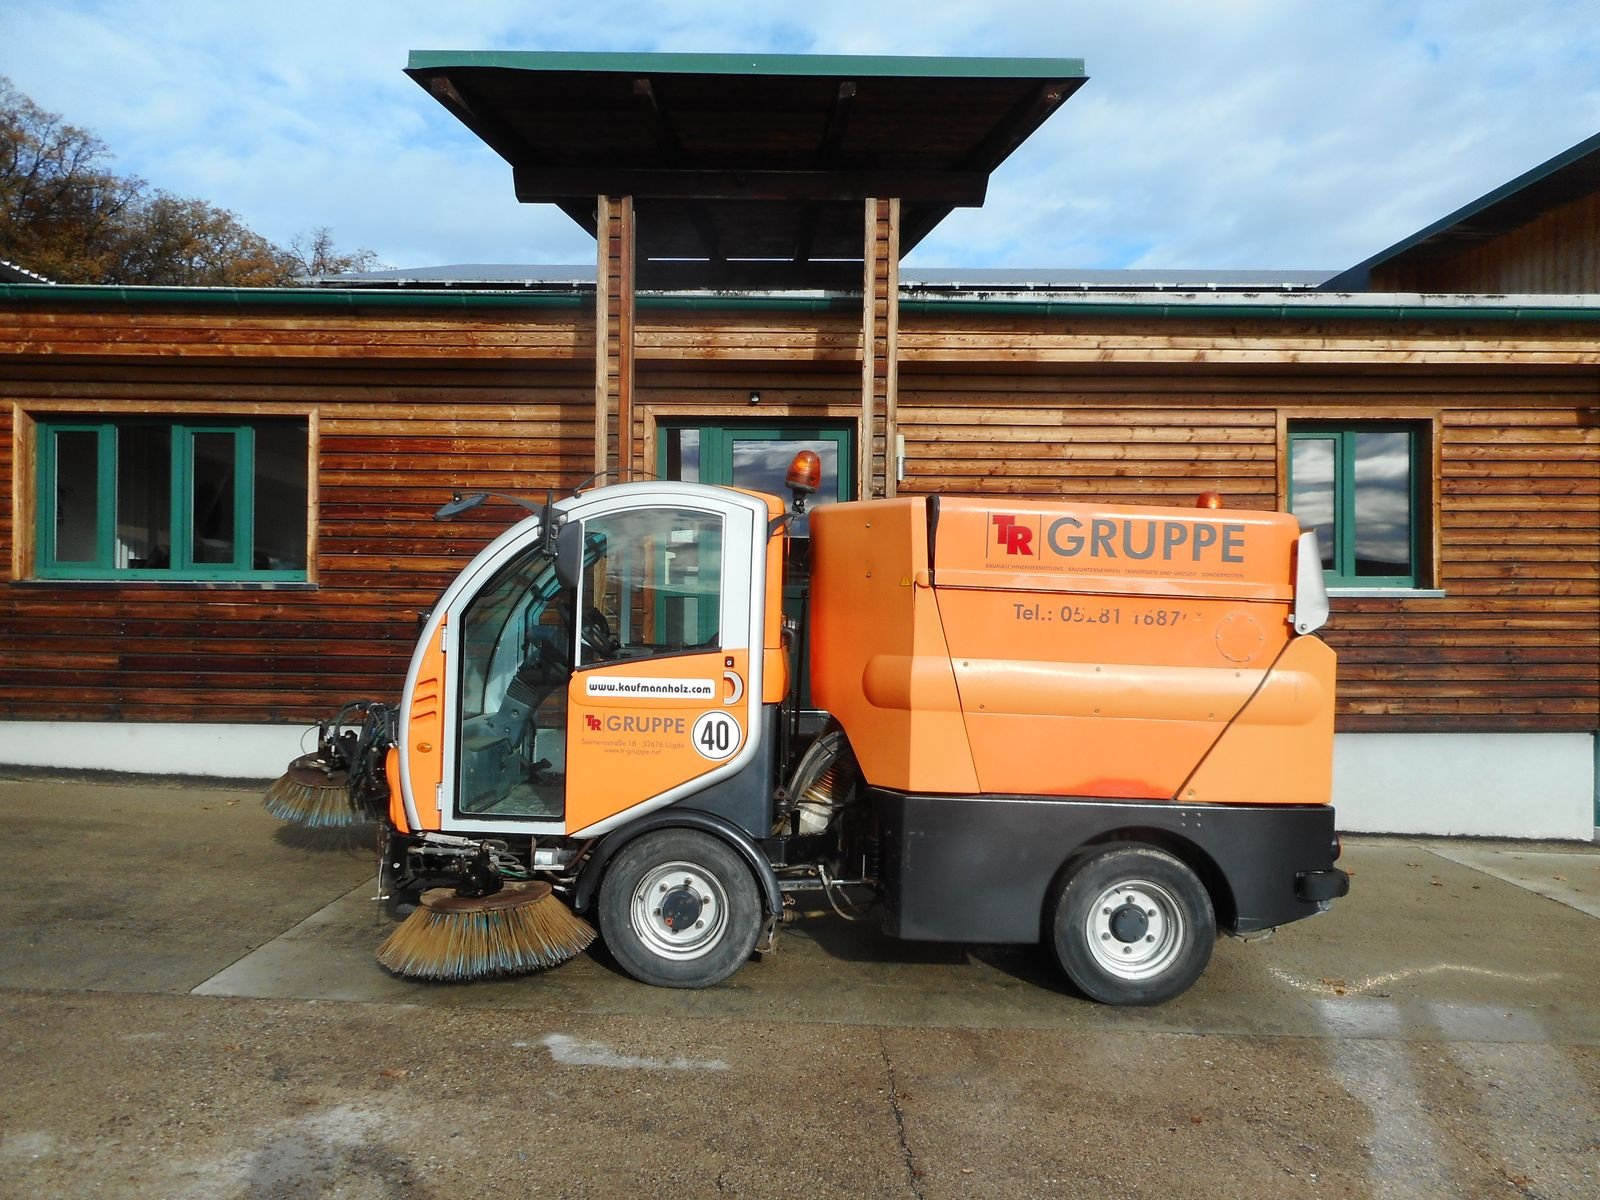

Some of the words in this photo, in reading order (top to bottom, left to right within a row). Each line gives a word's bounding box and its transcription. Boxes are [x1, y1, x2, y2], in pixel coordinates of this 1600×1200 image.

[992, 514, 1034, 556] TR
[1047, 516, 1245, 564] GRUPPE
[1013, 603, 1052, 621] Tel.:
[589, 682, 712, 695] www.kaufmannholz.com
[585, 714, 602, 732] TR
[606, 715, 685, 734] GRUPPE
[701, 720, 729, 751] 40
